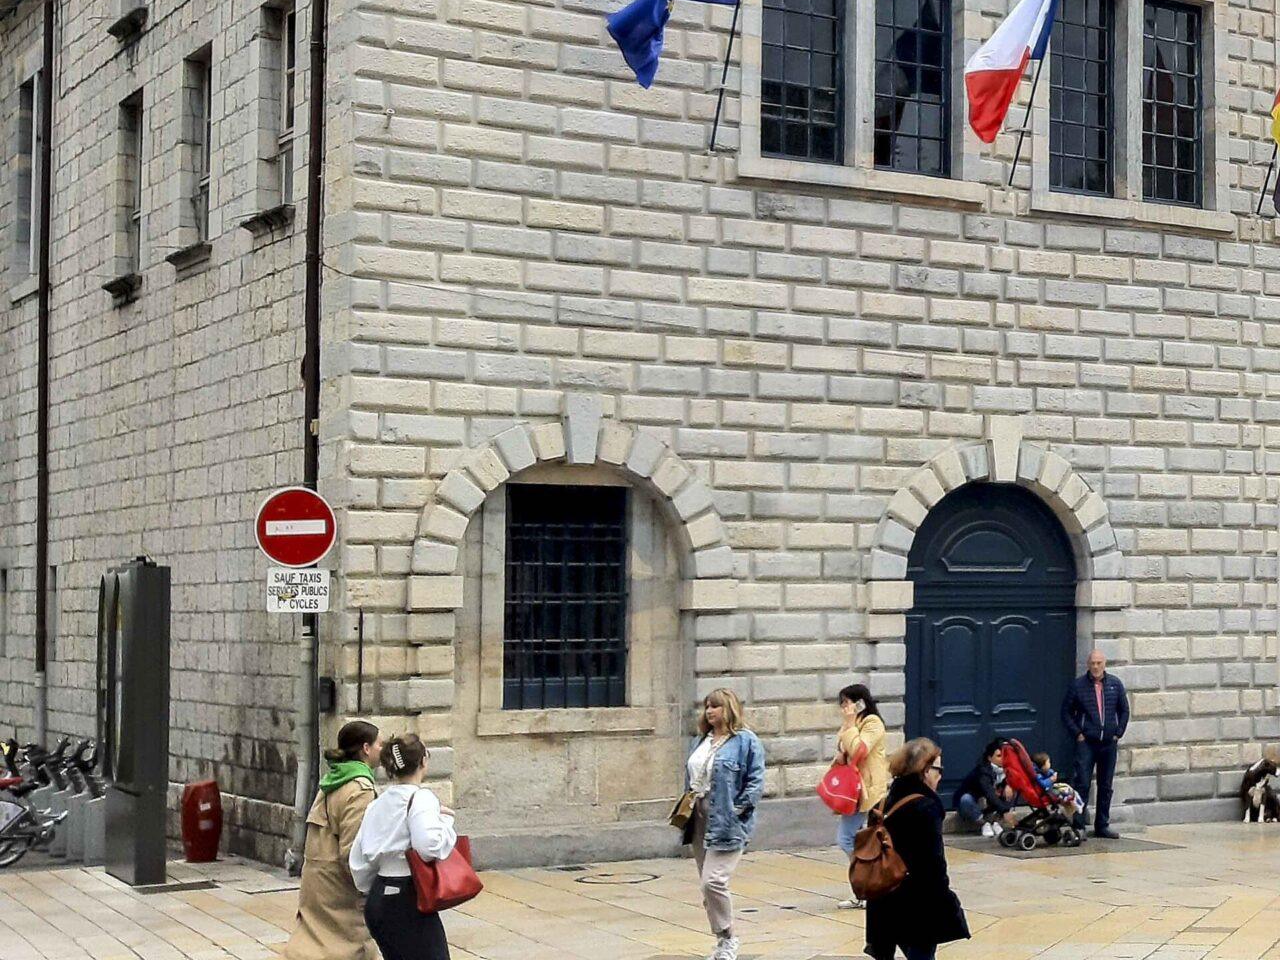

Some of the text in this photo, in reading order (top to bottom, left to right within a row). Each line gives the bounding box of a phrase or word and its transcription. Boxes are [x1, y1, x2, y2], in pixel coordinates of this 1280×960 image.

[274, 573, 322, 584] SAUF TAXIS
[301, 585, 328, 597] PUBLICS
[289, 598, 319, 610] CYCLES
